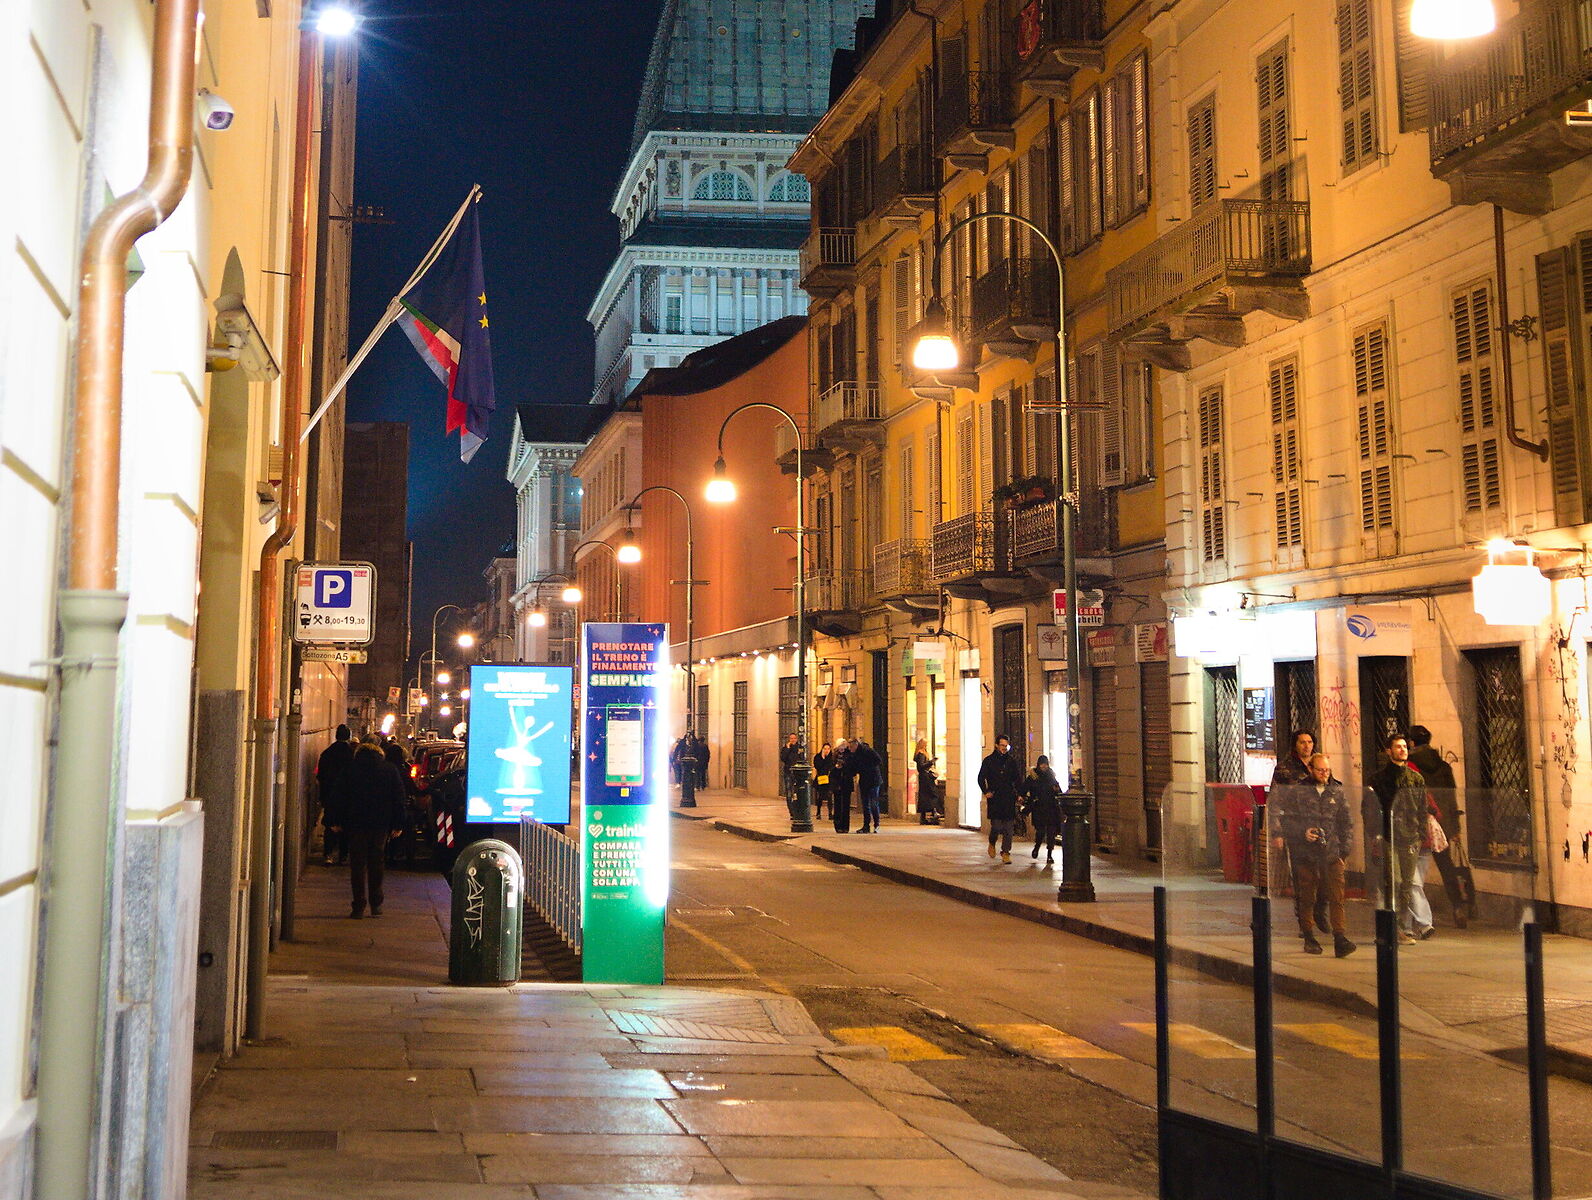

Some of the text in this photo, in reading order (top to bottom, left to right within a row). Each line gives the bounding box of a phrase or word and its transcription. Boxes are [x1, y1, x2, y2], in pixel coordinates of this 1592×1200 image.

[322, 575, 345, 604] P
[592, 642, 654, 651] PRENOTARE
[335, 652, 349, 661] A5
[592, 653, 602, 662] IL
[603, 653, 639, 662] TRENO
[590, 673, 655, 687] SEMPLIC
[593, 851, 642, 859] E PRENOT
[593, 860, 621, 868] TUTTI
[593, 869, 613, 878] CON
[593, 878, 618, 886] SOLA
